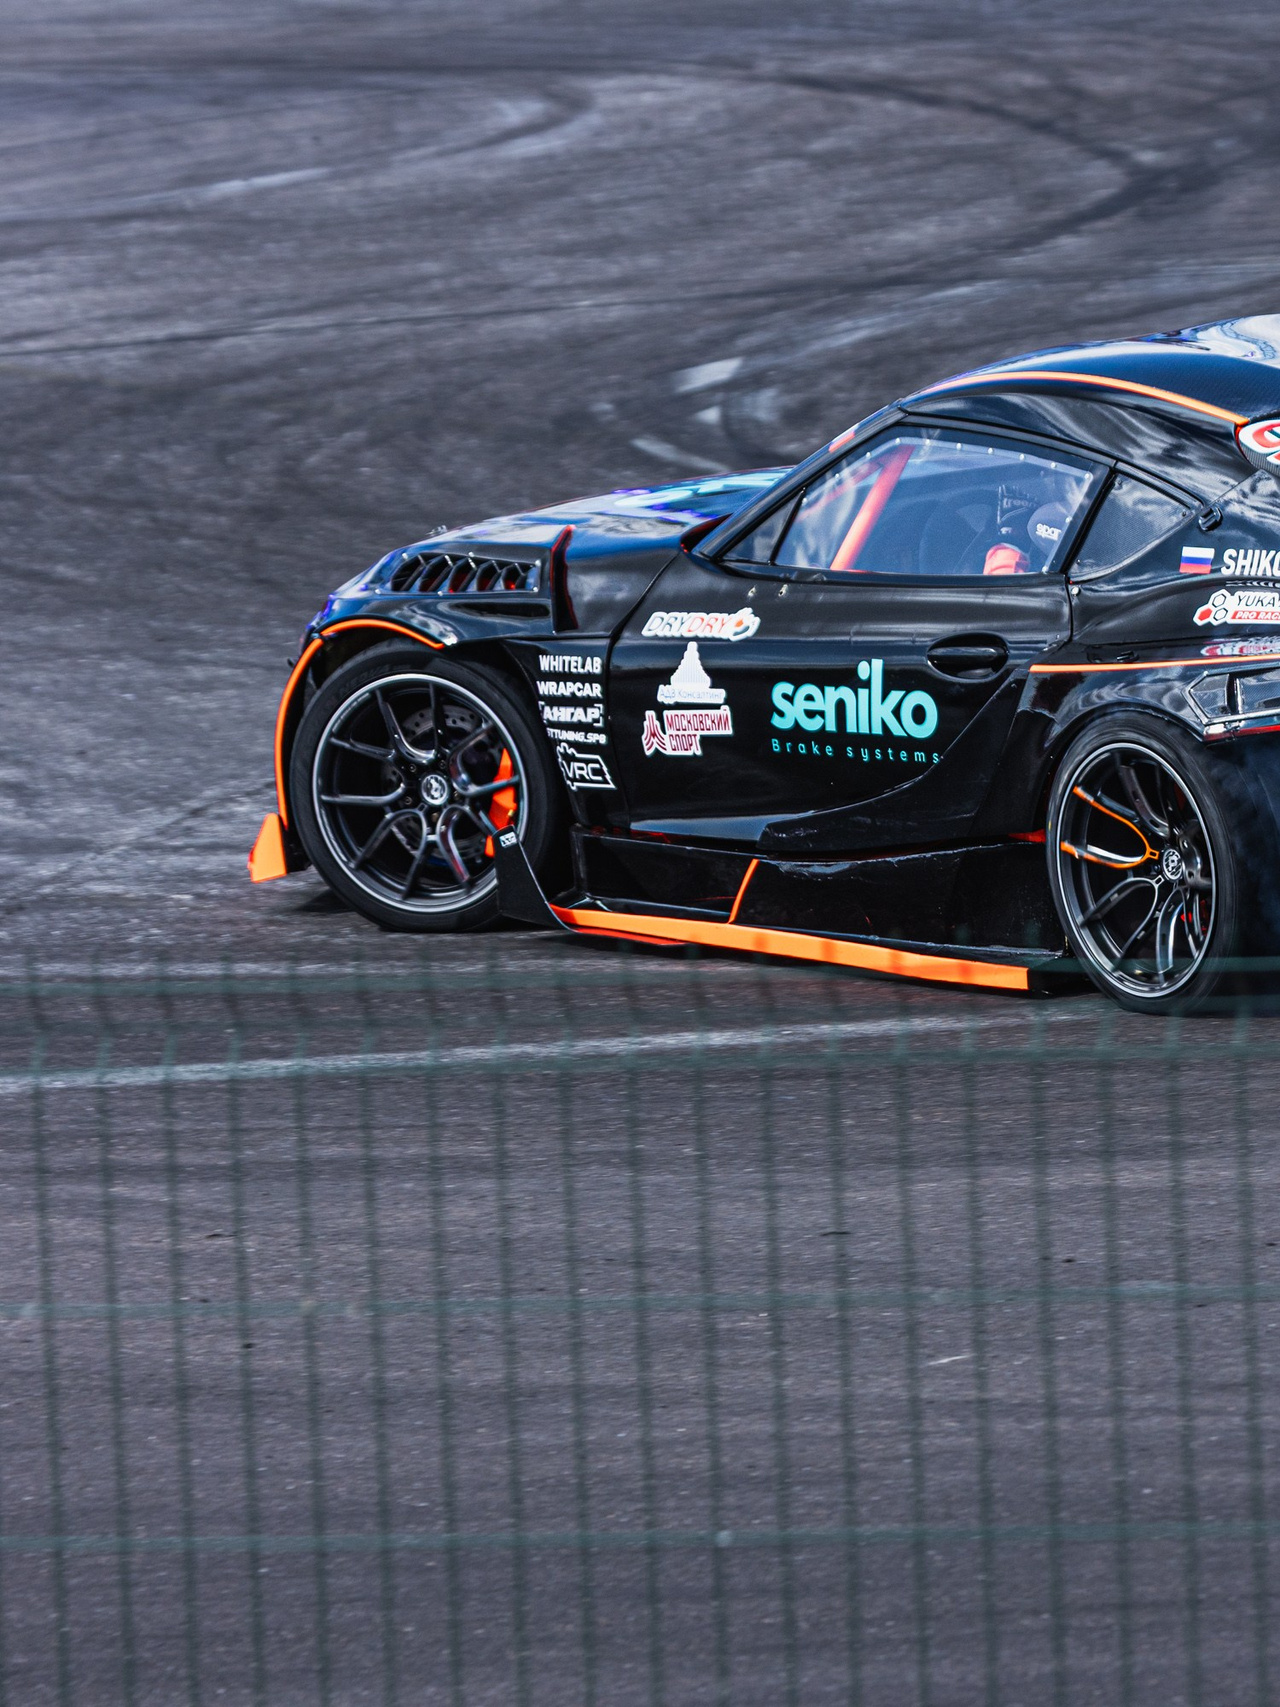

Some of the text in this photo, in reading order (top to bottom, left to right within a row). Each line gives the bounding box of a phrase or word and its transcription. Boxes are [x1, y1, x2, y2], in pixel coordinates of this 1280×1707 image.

[1237, 594, 1276, 607] YUKA
[1234, 611, 1257, 619] PRO
[539, 654, 602, 674] WHITELAB
[536, 681, 603, 698] WRAPCAR
[770, 658, 938, 739] seniko
[665, 708, 730, 731] МОСКОВСКИЙ
[668, 733, 699, 751] СПОРТ
[771, 738, 940, 764] Brake systems
[562, 760, 603, 781] VRC
